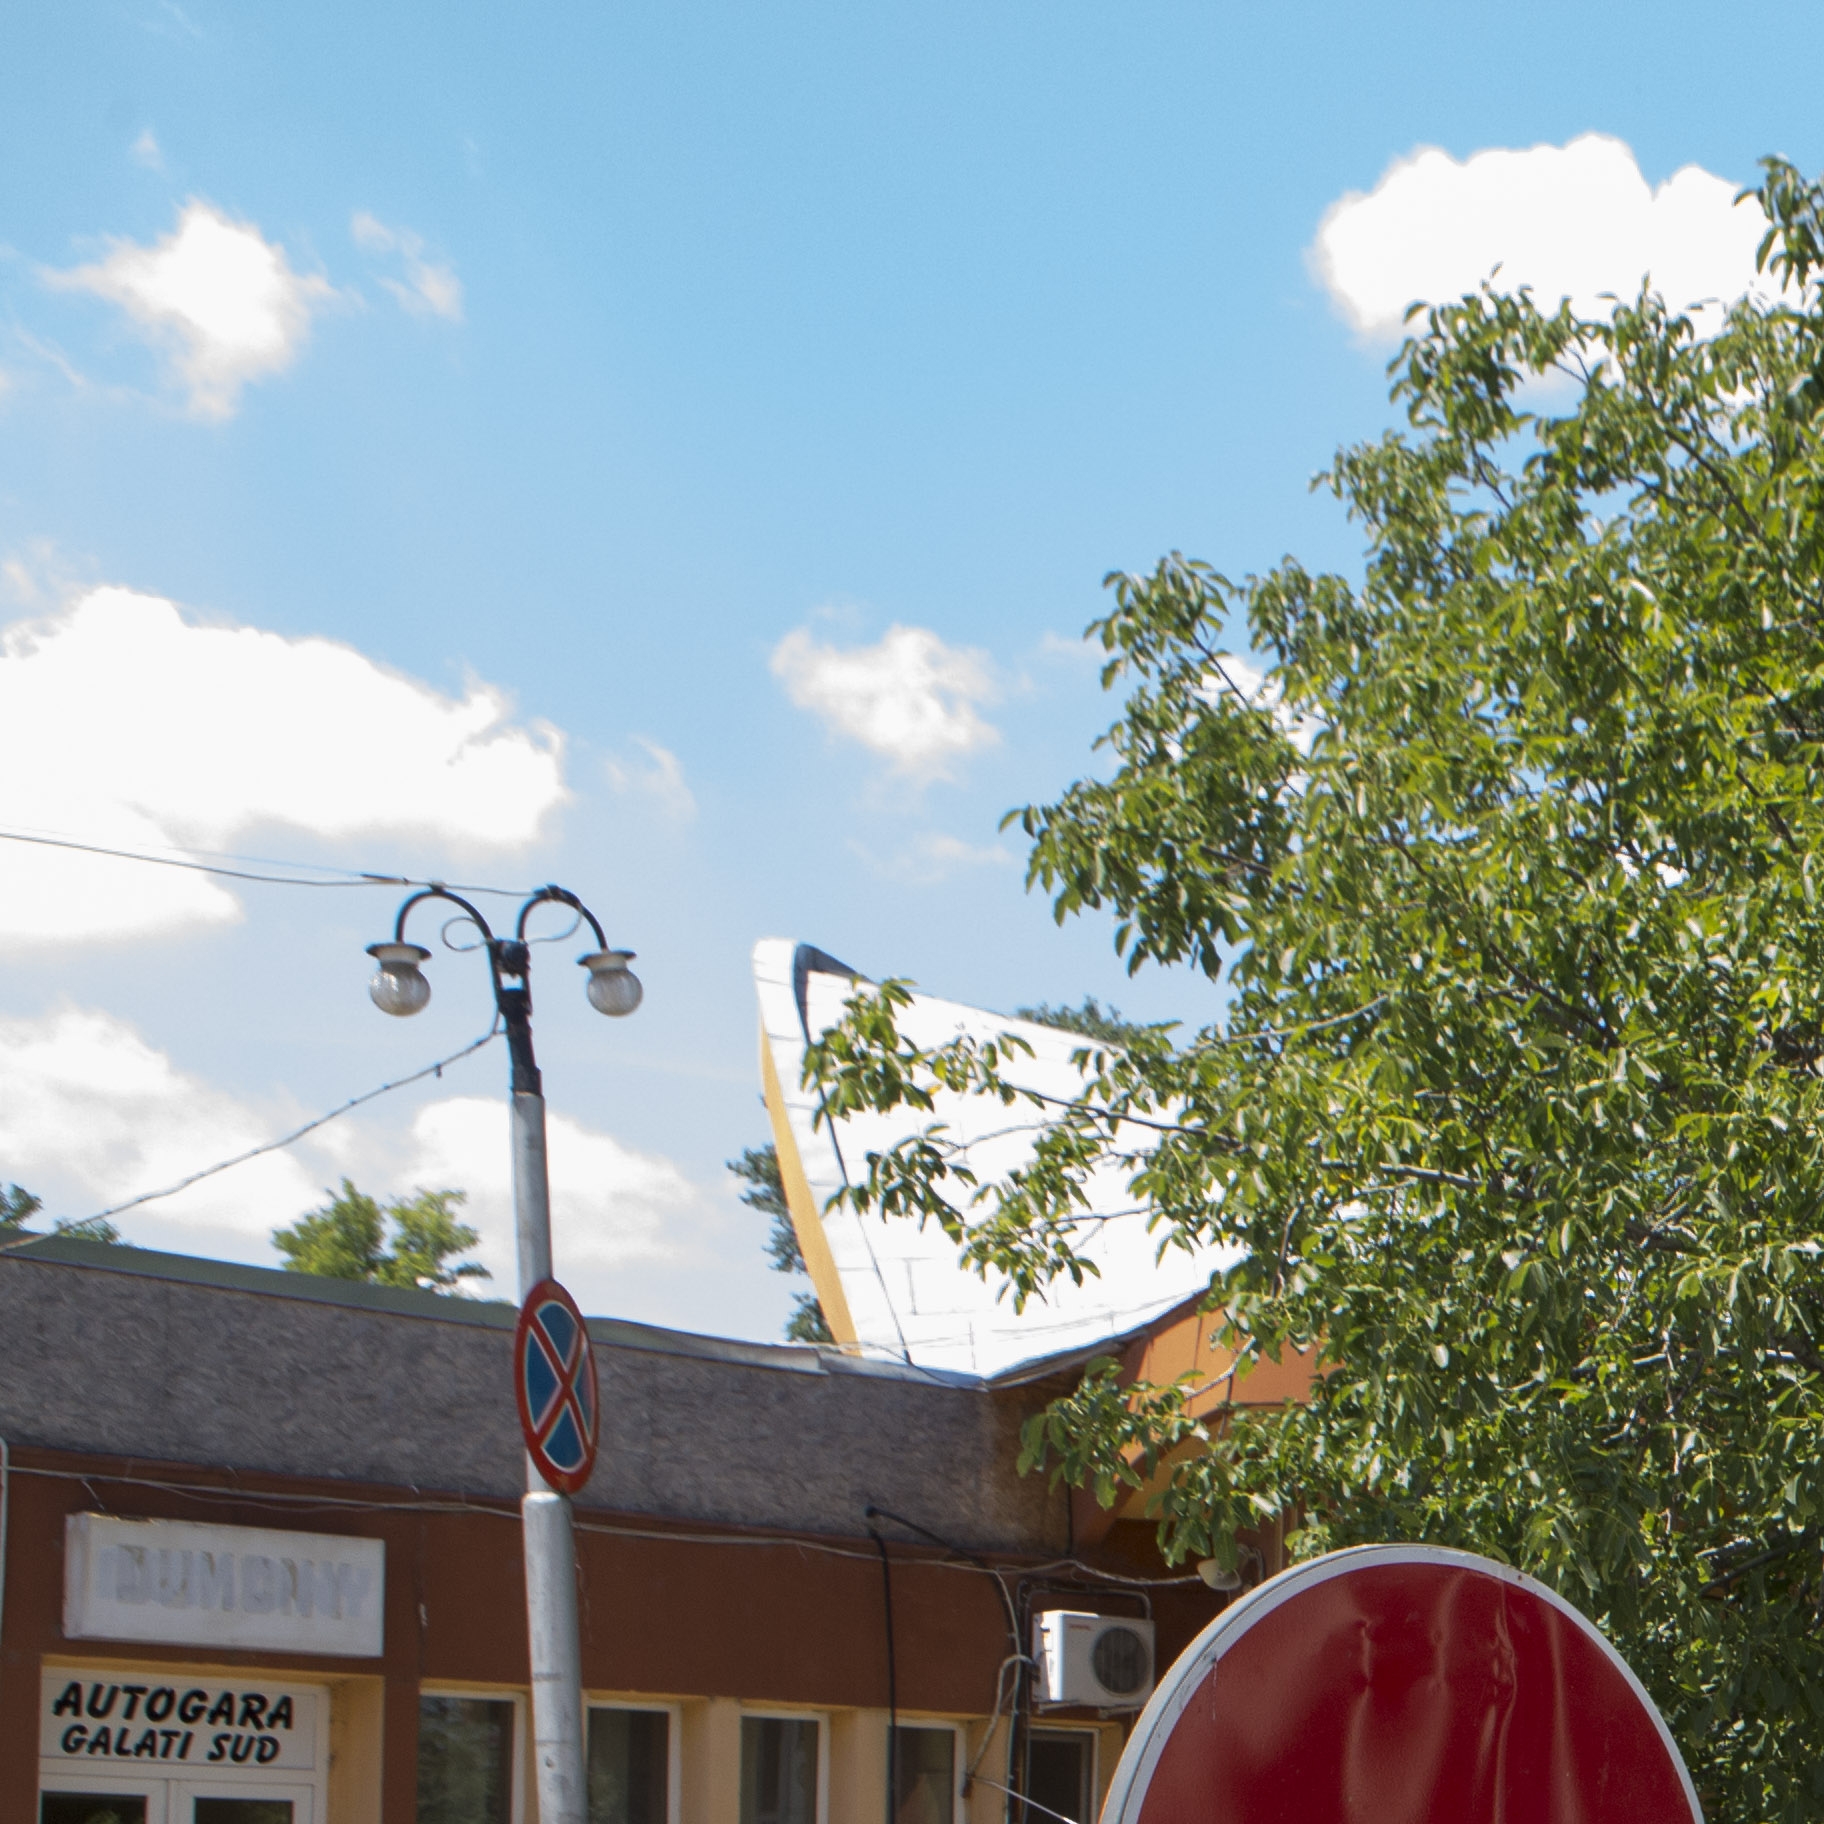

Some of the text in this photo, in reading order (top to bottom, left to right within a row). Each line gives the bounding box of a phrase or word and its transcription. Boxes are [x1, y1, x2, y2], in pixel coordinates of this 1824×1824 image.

[53, 1681, 294, 1731] AUTOGARA
[61, 1729, 281, 1765] GALATI SUD
